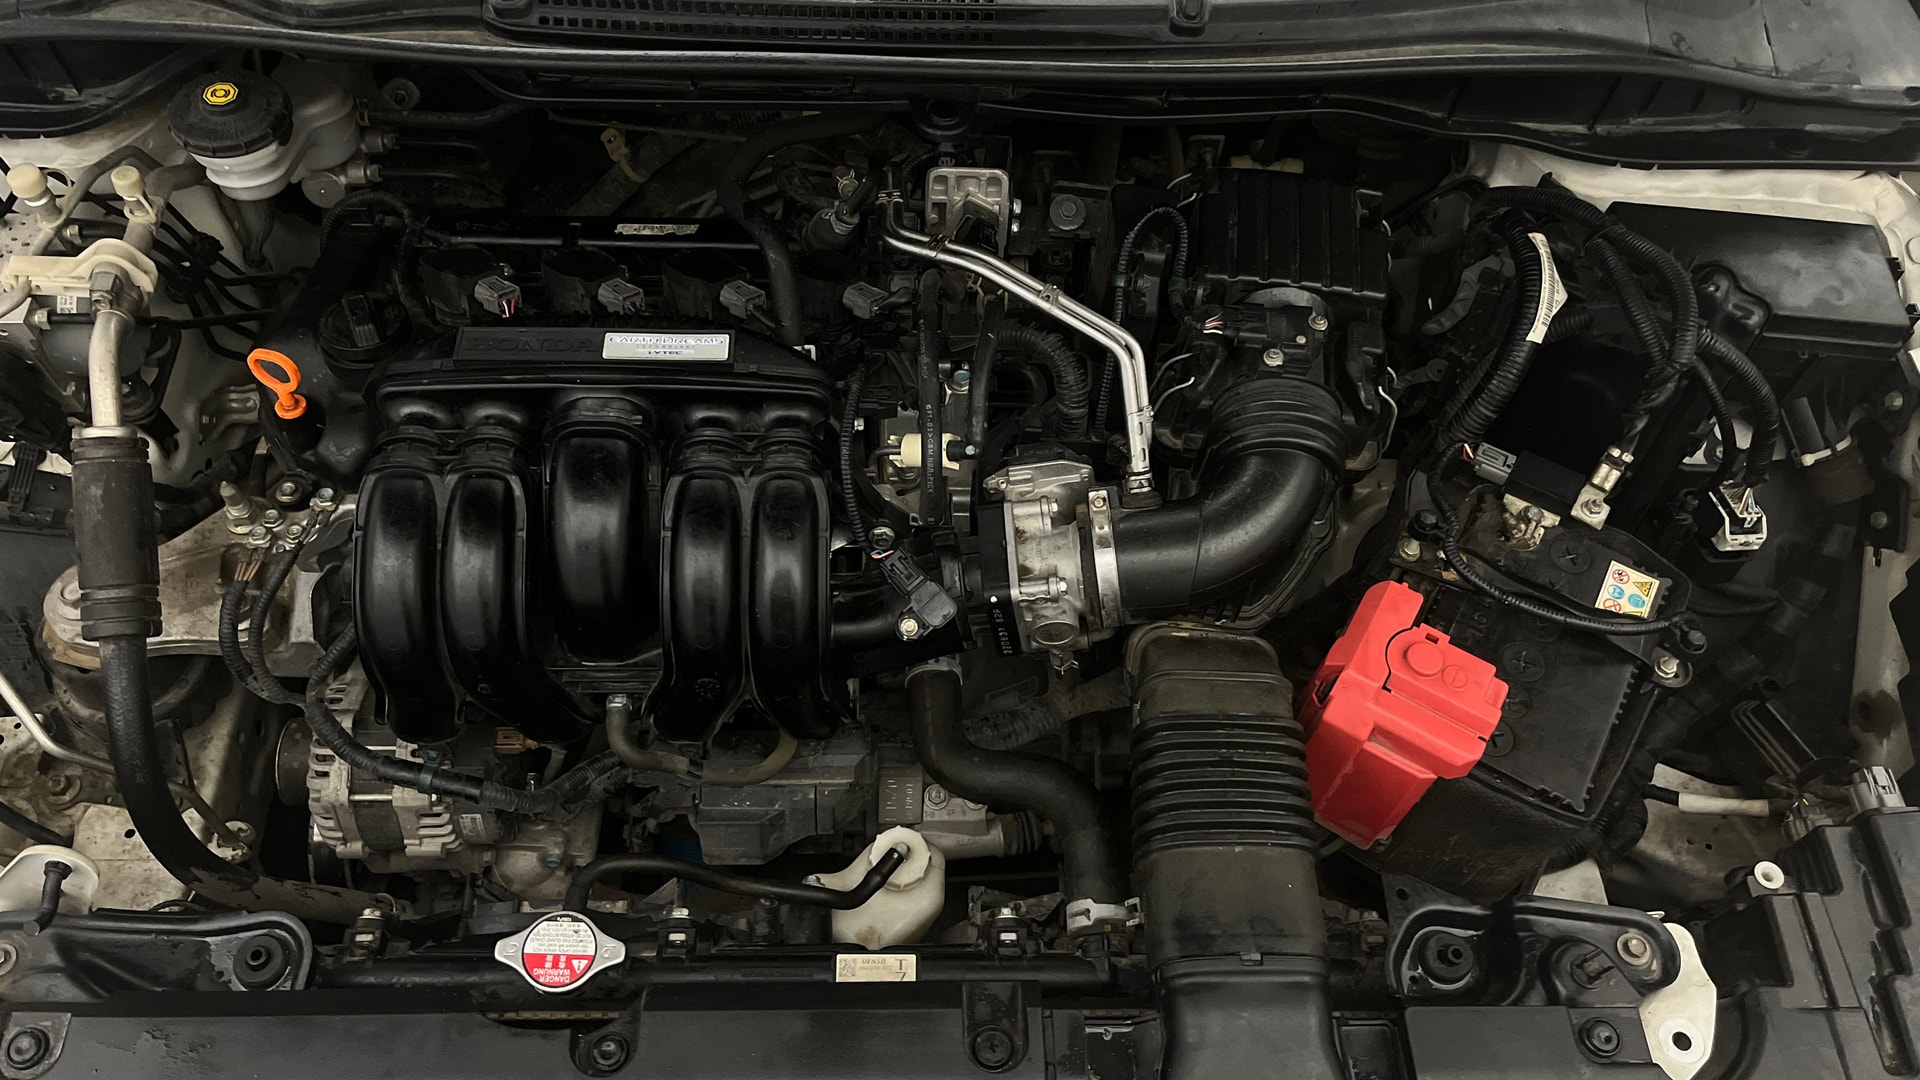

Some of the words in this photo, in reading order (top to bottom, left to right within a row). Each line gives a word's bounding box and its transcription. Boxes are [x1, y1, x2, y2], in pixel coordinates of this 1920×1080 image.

[464, 337, 600, 352] HONDA
[533, 968, 570, 976] WARNUNG
[539, 975, 570, 983] DANGER
